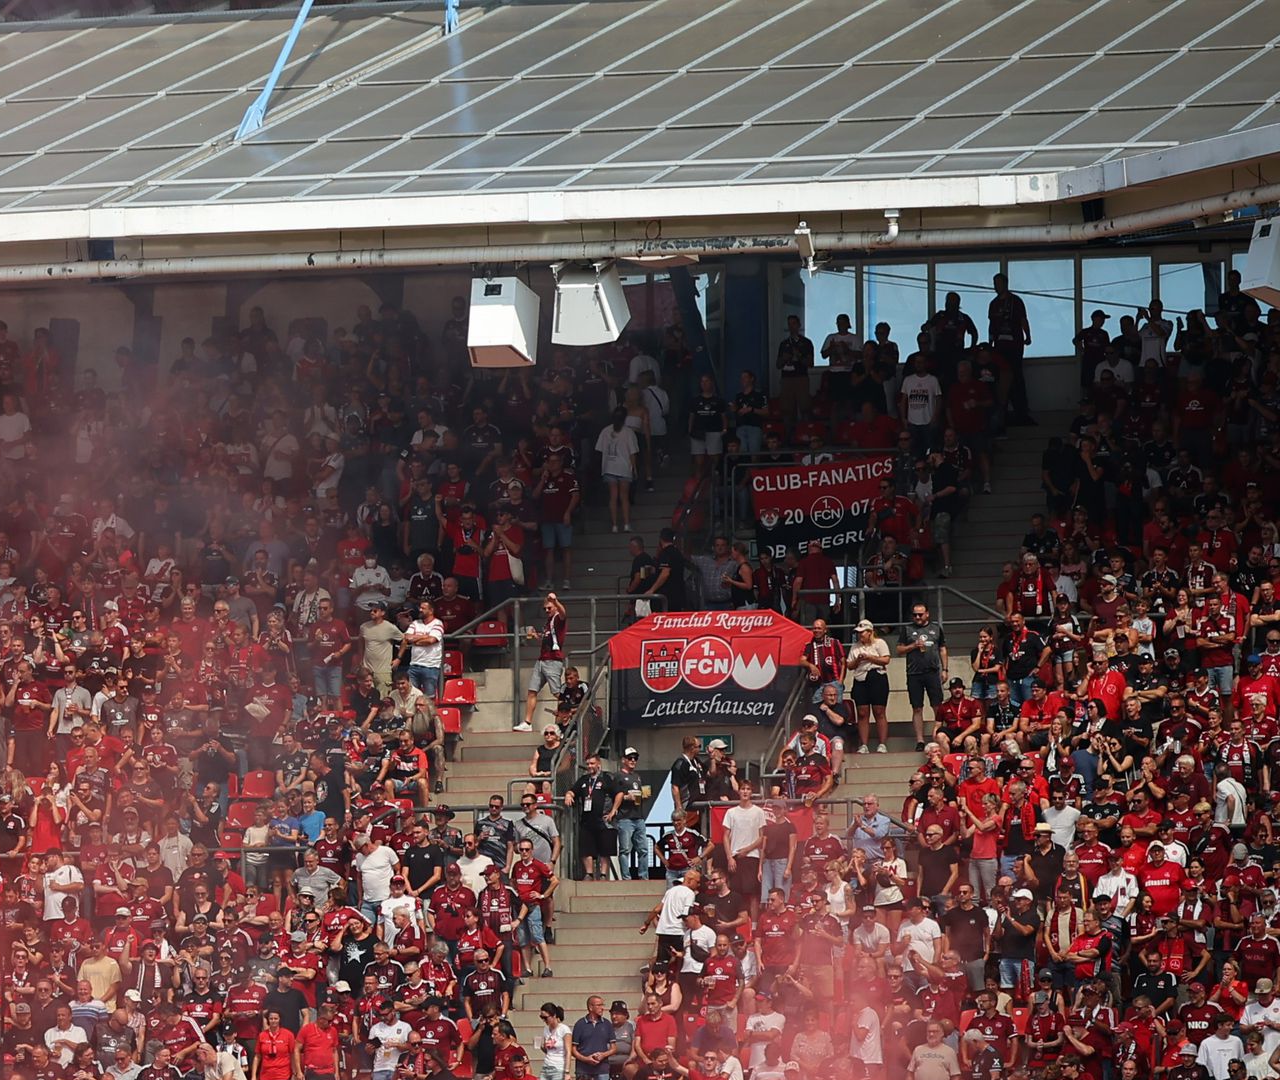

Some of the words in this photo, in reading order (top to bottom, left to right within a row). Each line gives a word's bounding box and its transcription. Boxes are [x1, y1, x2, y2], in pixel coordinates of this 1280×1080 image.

[752, 456, 894, 492] CLUB-FANATICS
[783, 508, 805, 525] 20
[813, 504, 842, 522] FCN
[650, 611, 712, 632] Fanclub
[714, 612, 774, 634] Rangau
[683, 657, 730, 675] FCN
[640, 693, 776, 719] Leutershausen
[1187, 1021, 1209, 1030] NKD
